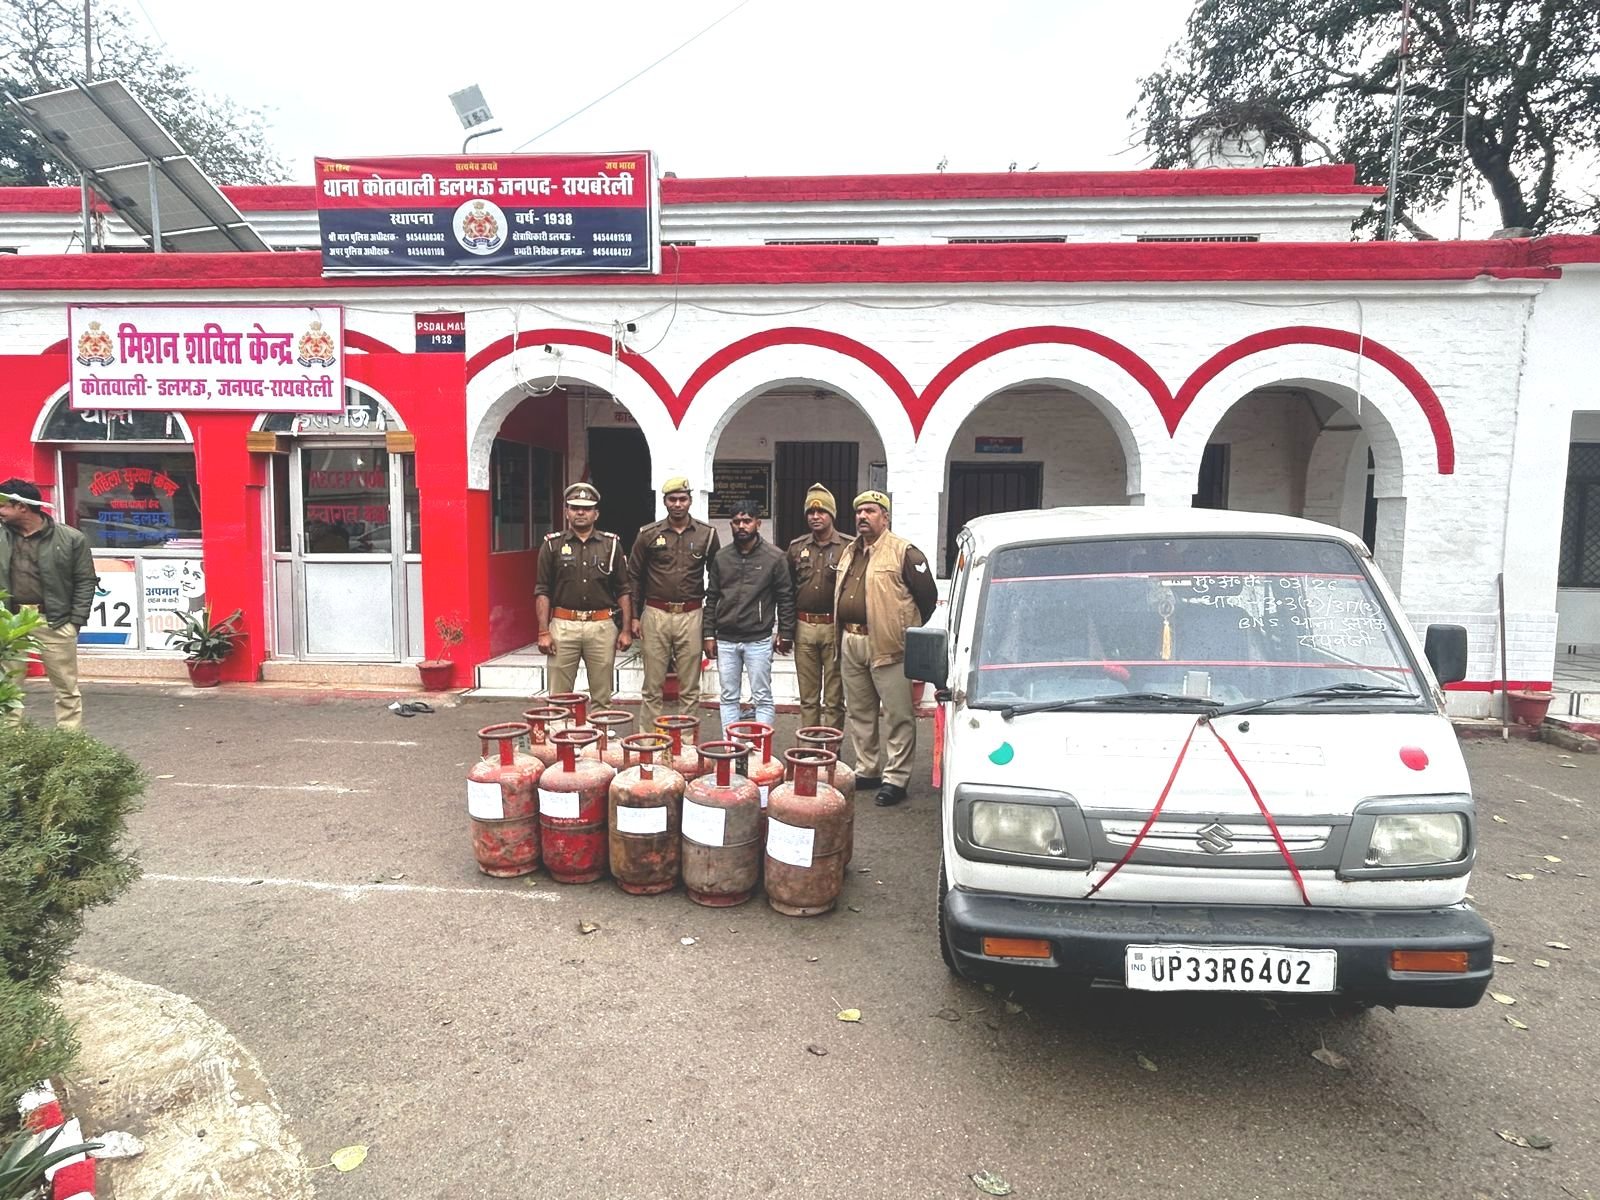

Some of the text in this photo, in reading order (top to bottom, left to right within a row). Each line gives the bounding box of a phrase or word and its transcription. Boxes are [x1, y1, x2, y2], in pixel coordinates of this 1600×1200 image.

[605, 161, 618, 170] जय
[323, 178, 360, 197] थाना
[362, 173, 436, 197] कोतवाली
[439, 177, 495, 197] डलमऊ
[562, 172, 634, 196] रायबरेली
[389, 213, 434, 225] स्थापना
[543, 212, 573, 225] 1938
[350, 231, 369, 244] पुलिस
[344, 246, 363, 258] पुलिस
[118, 322, 294, 366] मिशन शक्ति केन्द्र
[432, 334, 452, 345] 1938
[310, 471, 385, 488] RECEPTION
[145, 587, 179, 596] अपमान
[84, 601, 131, 628] 12
[1131, 963, 1146, 972] IND
[1151, 955, 1311, 985] UP33R6402
